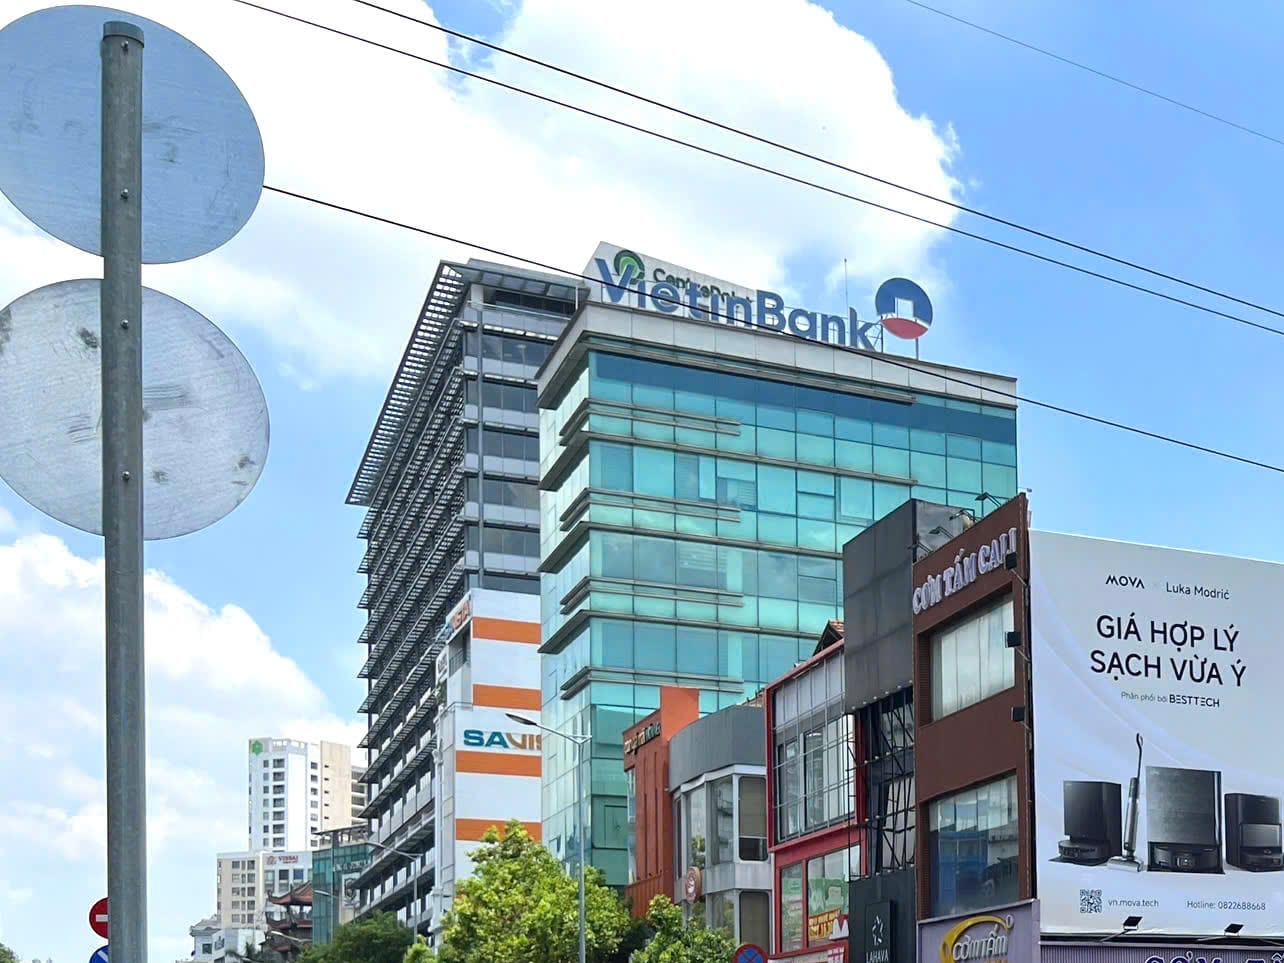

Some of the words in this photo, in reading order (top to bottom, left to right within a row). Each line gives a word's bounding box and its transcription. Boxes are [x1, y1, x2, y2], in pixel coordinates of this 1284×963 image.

[595, 257, 876, 351] VietinBank
[1105, 575, 1145, 589] MOVA
[1166, 582, 1191, 595] Luka
[1194, 586, 1230, 600] Modrić
[1096, 612, 1142, 641] GIÁ
[1150, 620, 1205, 652] HỢP
[1213, 623, 1239, 652] LÝ
[1090, 650, 1161, 681] SẠCH
[1169, 654, 1223, 685] VỪA
[1231, 659, 1247, 687] Ý
[1169, 694, 1220, 707] BESTTECH
[1187, 901, 1215, 909] Hotline:
